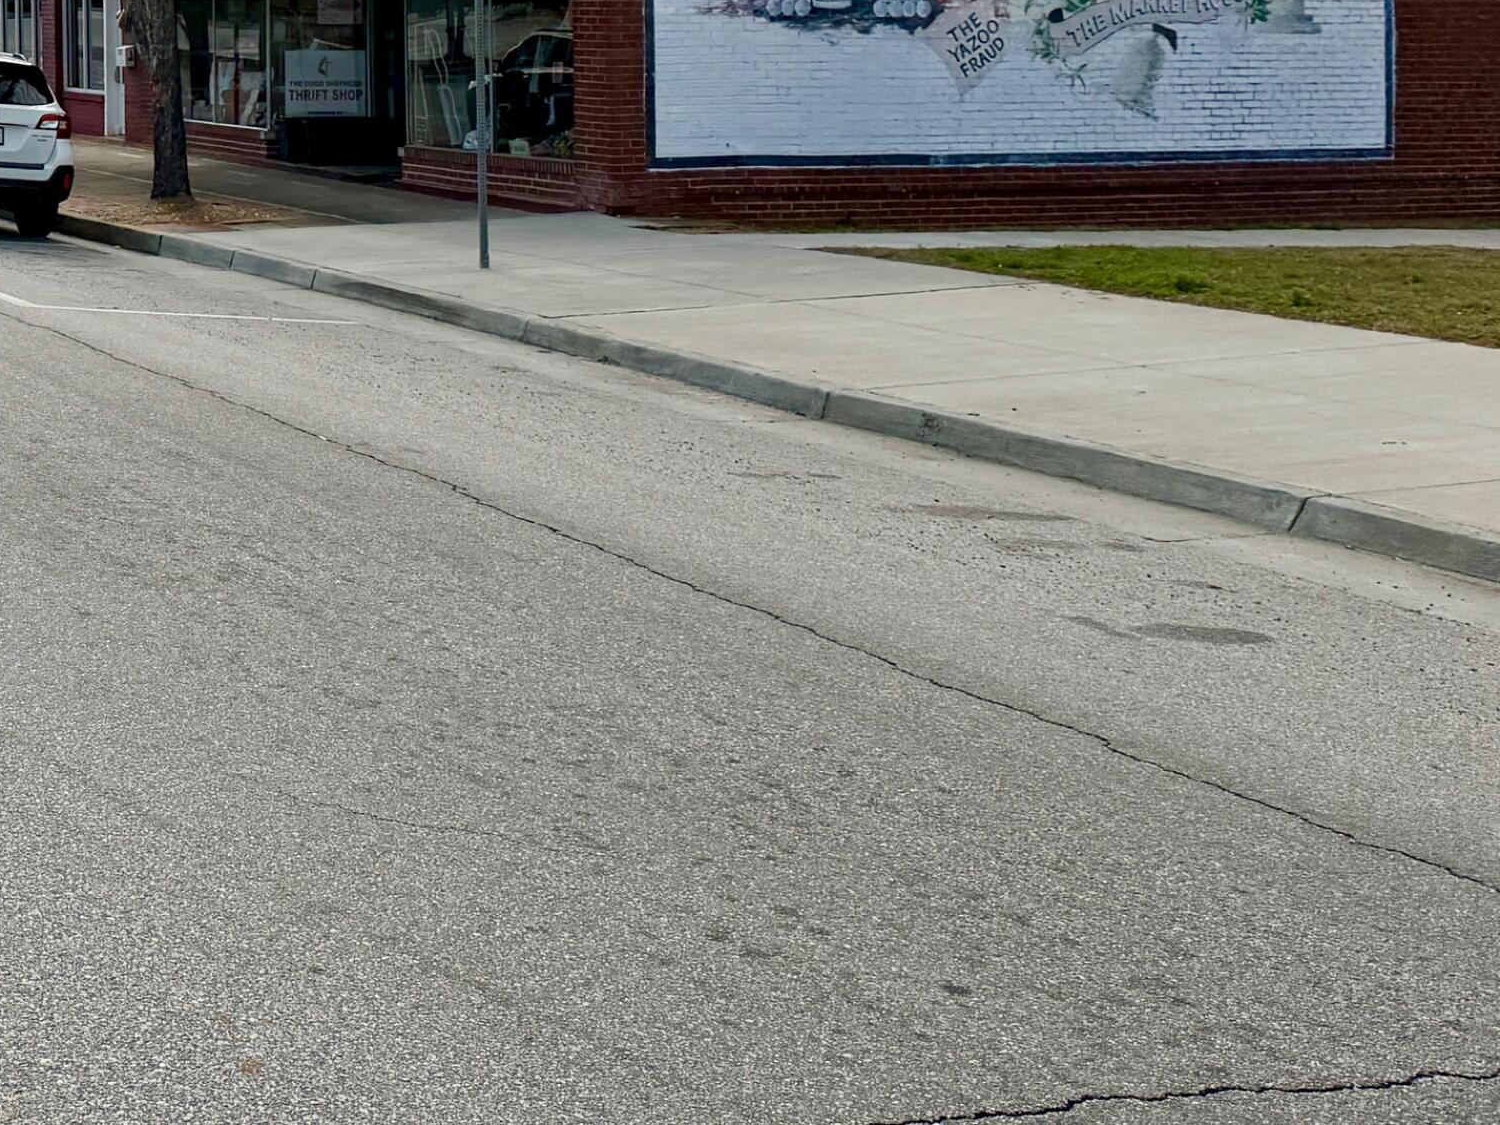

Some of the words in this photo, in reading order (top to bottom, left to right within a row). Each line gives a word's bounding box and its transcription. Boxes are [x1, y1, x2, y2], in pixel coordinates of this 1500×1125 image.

[946, 12, 982, 42] THE
[947, 20, 999, 62] YAZOO
[1066, 14, 1110, 47] THE
[960, 37, 1004, 78] FRAUD
[289, 89, 329, 101] THRIFT
[332, 89, 363, 101] SHOP
